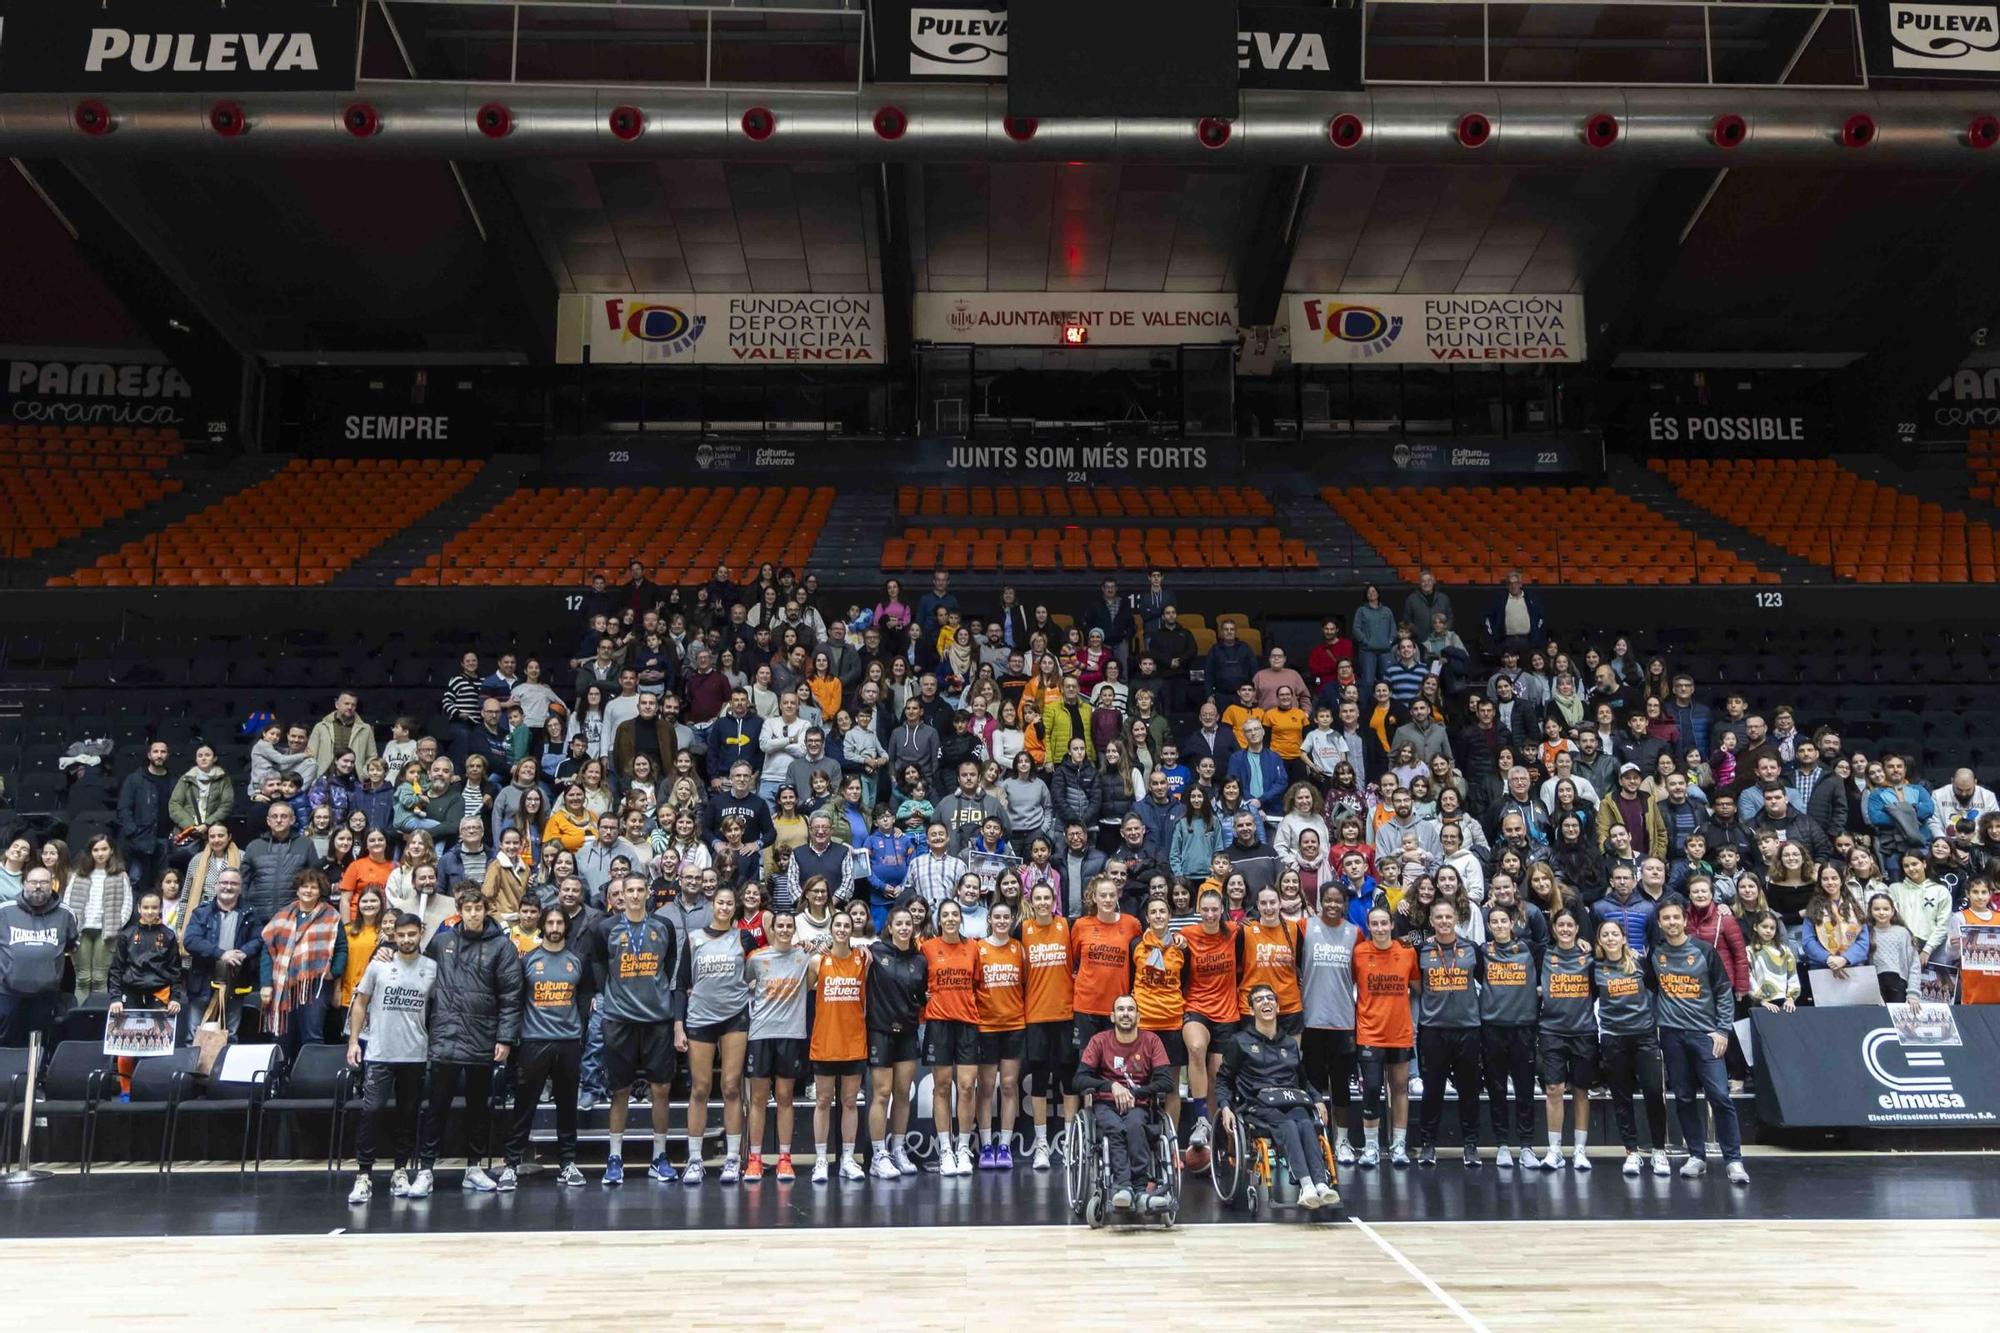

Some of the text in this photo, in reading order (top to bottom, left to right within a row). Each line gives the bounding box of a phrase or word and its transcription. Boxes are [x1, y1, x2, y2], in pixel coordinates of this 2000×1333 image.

[1897, 11, 1993, 32] PULEVA
[85, 28, 318, 71] PULEVA
[730, 296, 870, 313] FUNDACIÓN
[1425, 297, 1563, 315] FUNDACIÓN
[730, 316, 871, 330] DEPORTIVA
[978, 311, 1232, 326] AJUNTAMENT DE VALENCIA
[1426, 316, 1565, 331] DEPORTIVA
[729, 333, 871, 346] MUNICIPAL
[1427, 333, 1566, 347] MUNICIPAL
[731, 348, 873, 360] VALENCIA
[1431, 348, 1568, 360] VALENCIA
[8, 361, 191, 398] PAMESA
[345, 416, 449, 439] SEMPRE
[1650, 412, 1804, 440] ÉS POSSIBLE
[609, 451, 629, 462] 225
[946, 442, 1207, 469] JUNTS SOM MÉS FORTS
[1537, 452, 1558, 464] 223
[1067, 471, 1087, 483] 224
[1755, 592, 1783, 608] 123
[621, 952, 652, 962] Culura
[1029, 952, 1066, 963] Esfuerzo
[1428, 967, 1459, 976] Culta
[1487, 962, 1517, 971] Cultura
[825, 976, 856, 986] Cultura
[1487, 970, 1526, 980] Esfuerzo
[1550, 973, 1582, 983] Cultura
[385, 986, 419, 997] Cultura
[534, 981, 568, 991] Cultura
[383, 996, 424, 1008] Esfuerzo
[1878, 1091, 1966, 1109] elmusa
